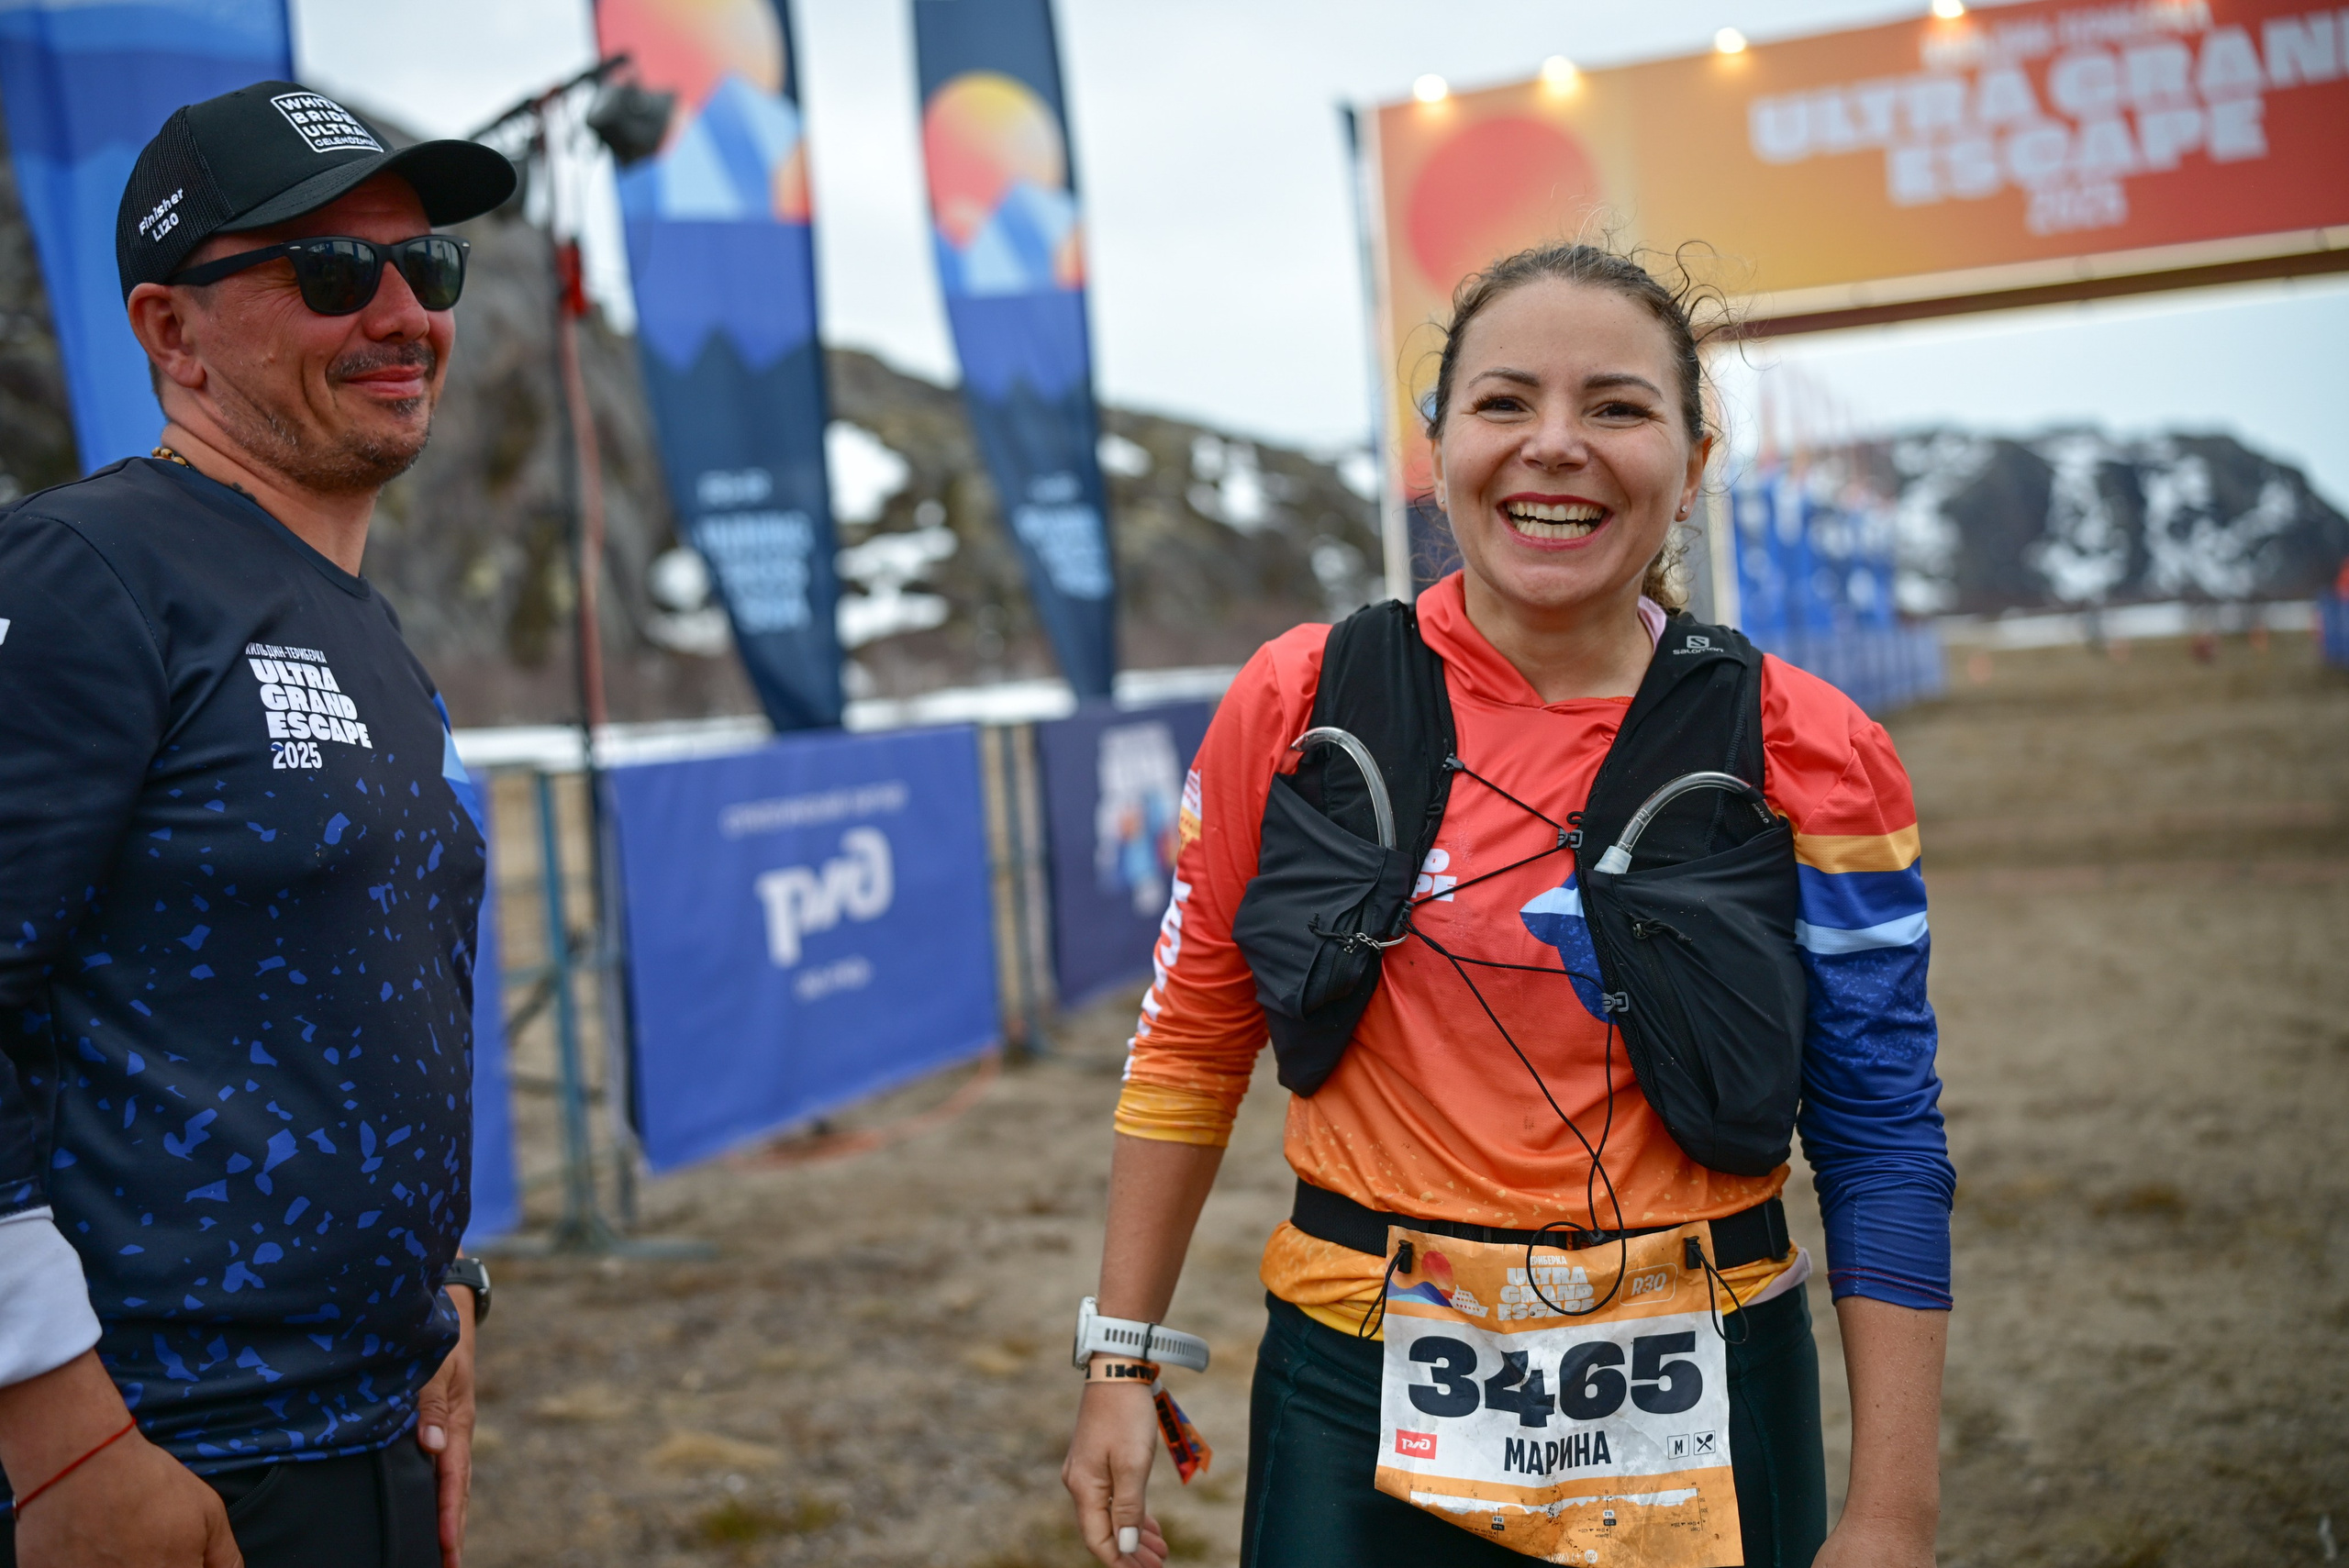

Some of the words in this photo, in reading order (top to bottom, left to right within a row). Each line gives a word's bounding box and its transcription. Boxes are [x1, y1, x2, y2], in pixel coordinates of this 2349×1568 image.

[1748, 67, 2039, 165] ULTRA
[2046, 9, 2349, 121] GRAN
[278, 96, 345, 113] WHITE
[290, 109, 359, 126] BRIDE
[302, 123, 370, 138] ULTRA
[1886, 95, 2268, 208] ESCAPE
[139, 187, 184, 237] Finisher
[151, 212, 180, 243] L120
[248, 658, 341, 694] ULTRA
[260, 684, 359, 721] GRAND
[265, 711, 373, 749] ESCAPE
[270, 741, 323, 770] 2025
[1506, 1266, 1588, 1285] ULTRA
[1529, 1255, 1568, 1265] ЕРИБЕРКА
[1499, 1284, 1595, 1304] GRAND
[1631, 1272, 1667, 1296] R30
[1408, 1330, 1704, 1428] 3465
[1504, 1429, 1612, 1476] МАРИНА
